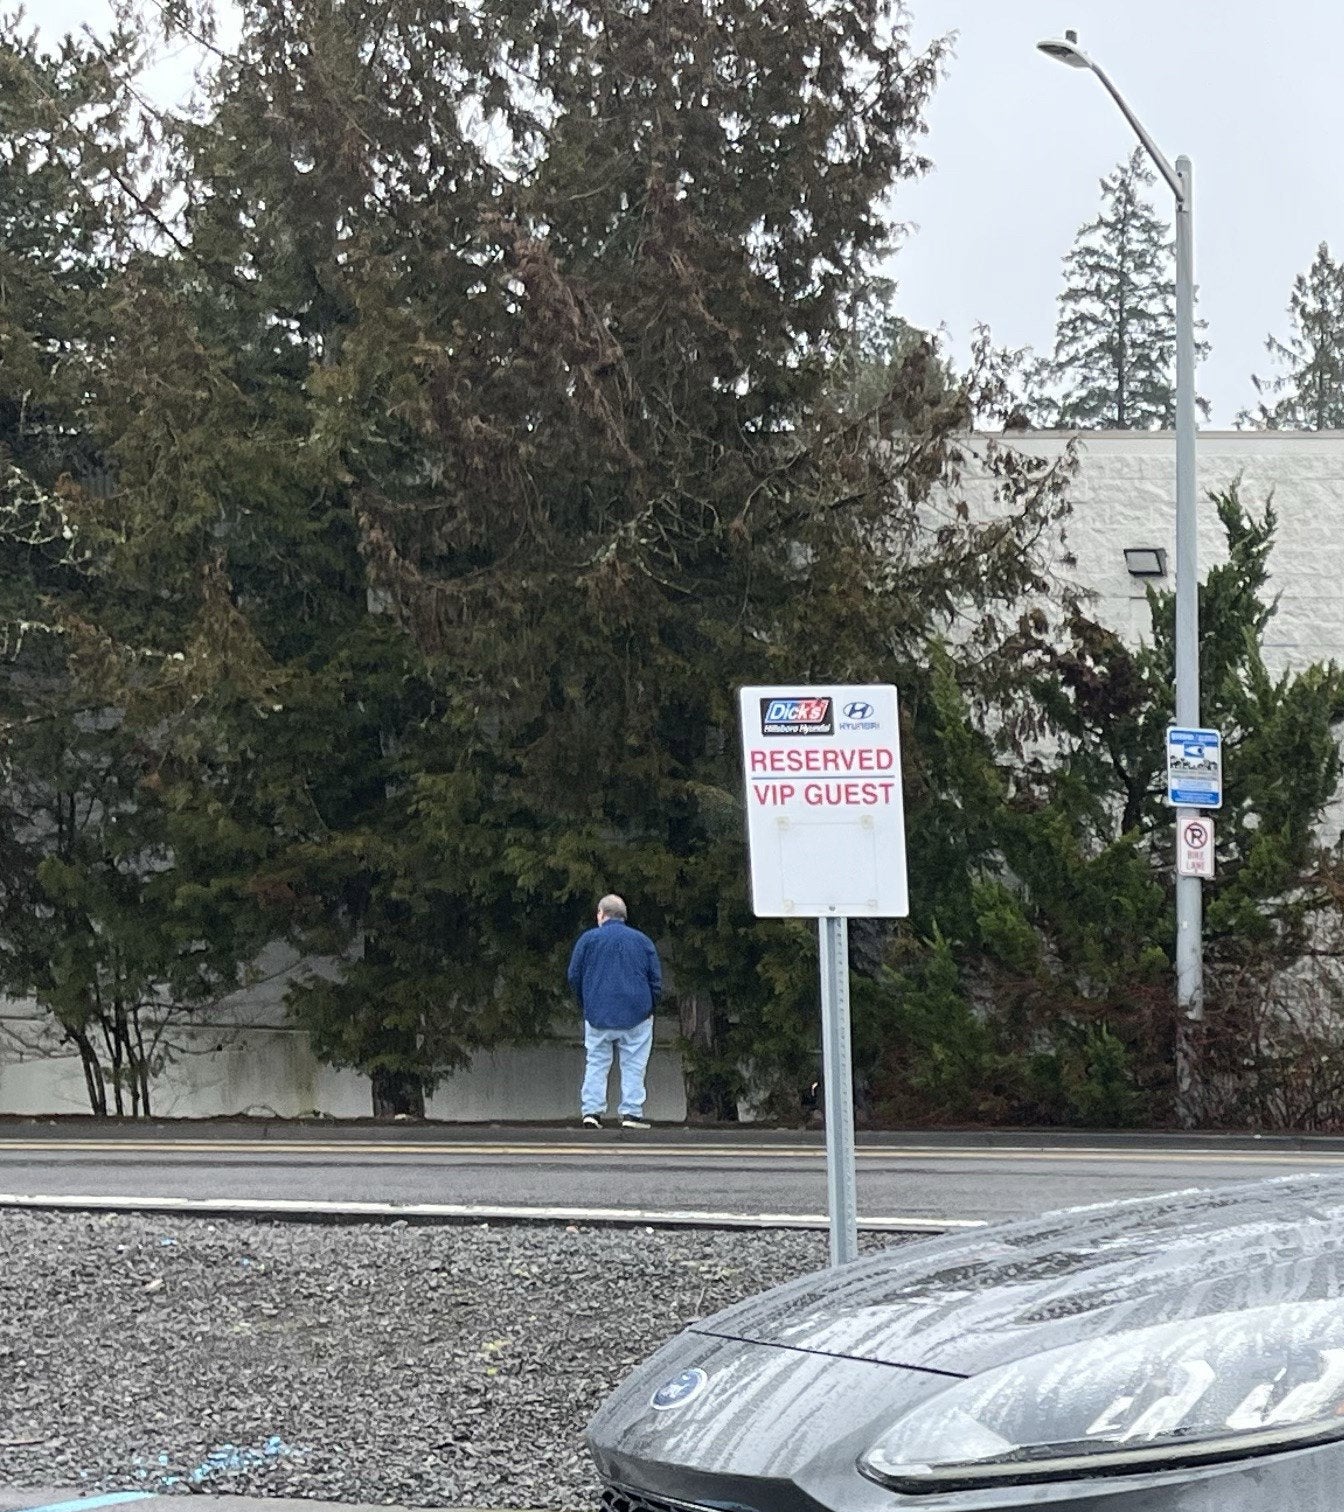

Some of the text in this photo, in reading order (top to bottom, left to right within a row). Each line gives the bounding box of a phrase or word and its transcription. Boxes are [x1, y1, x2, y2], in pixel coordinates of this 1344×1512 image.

[751, 749, 894, 772] RESERVED
[753, 783, 895, 806] VIP GUEST
